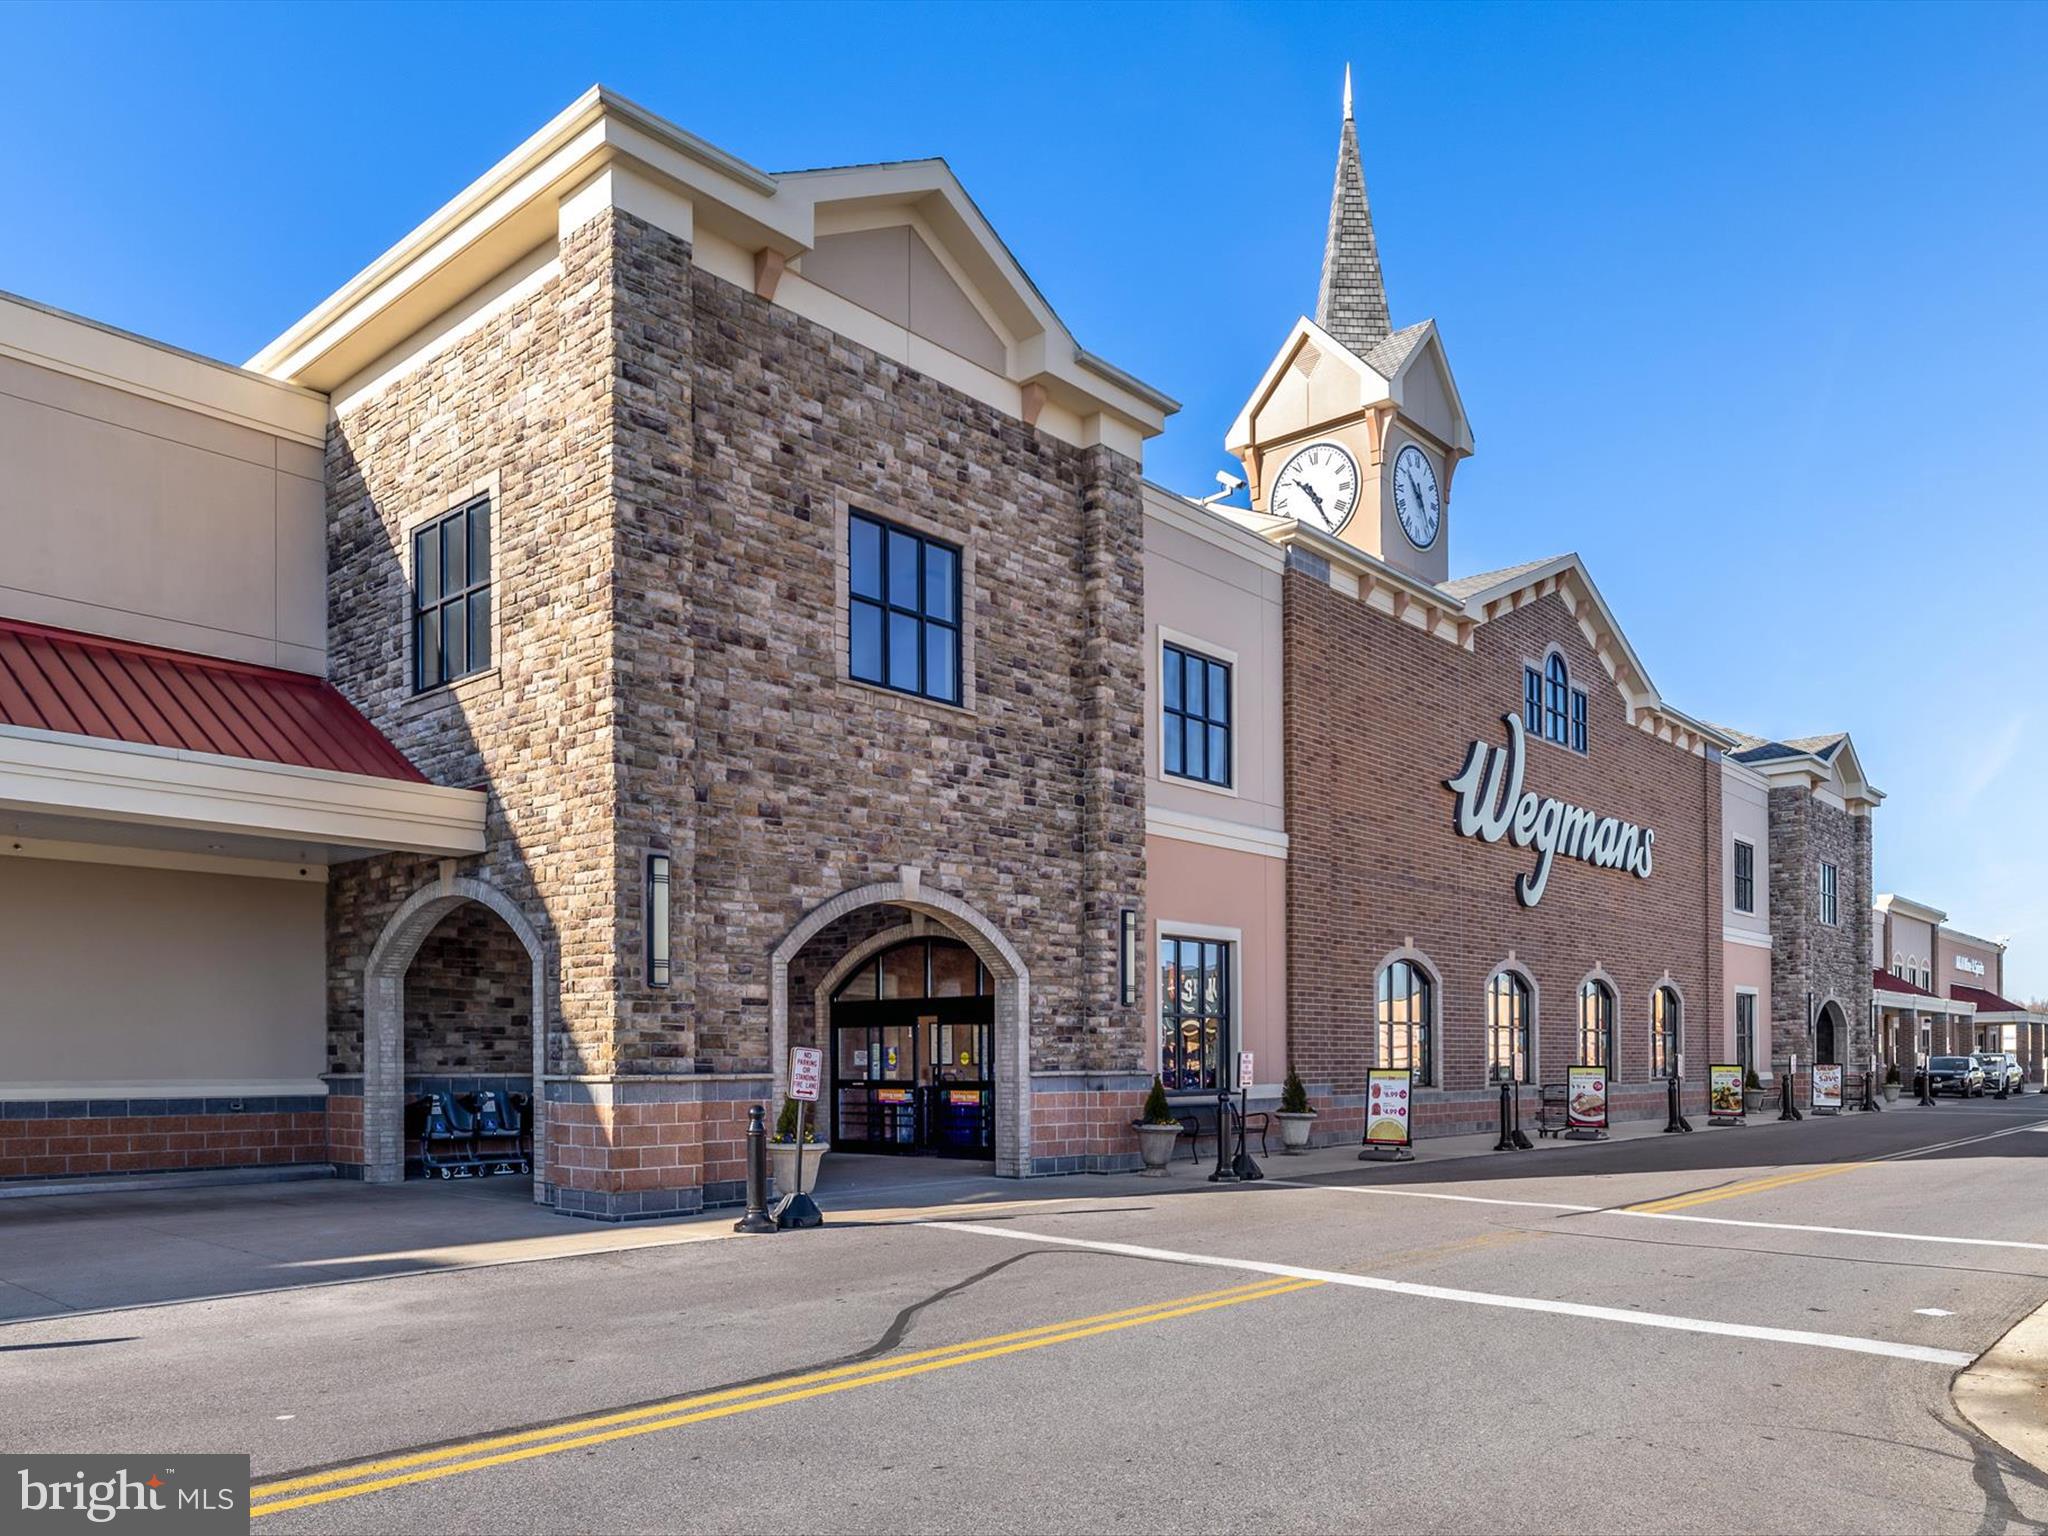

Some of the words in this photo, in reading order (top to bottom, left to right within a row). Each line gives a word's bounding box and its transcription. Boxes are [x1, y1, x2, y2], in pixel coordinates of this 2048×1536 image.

[1443, 712, 1655, 907] Wegmans
[803, 1051, 812, 1060] NO
[797, 1059, 817, 1067] PARKING
[795, 1073, 817, 1082] STANDING
